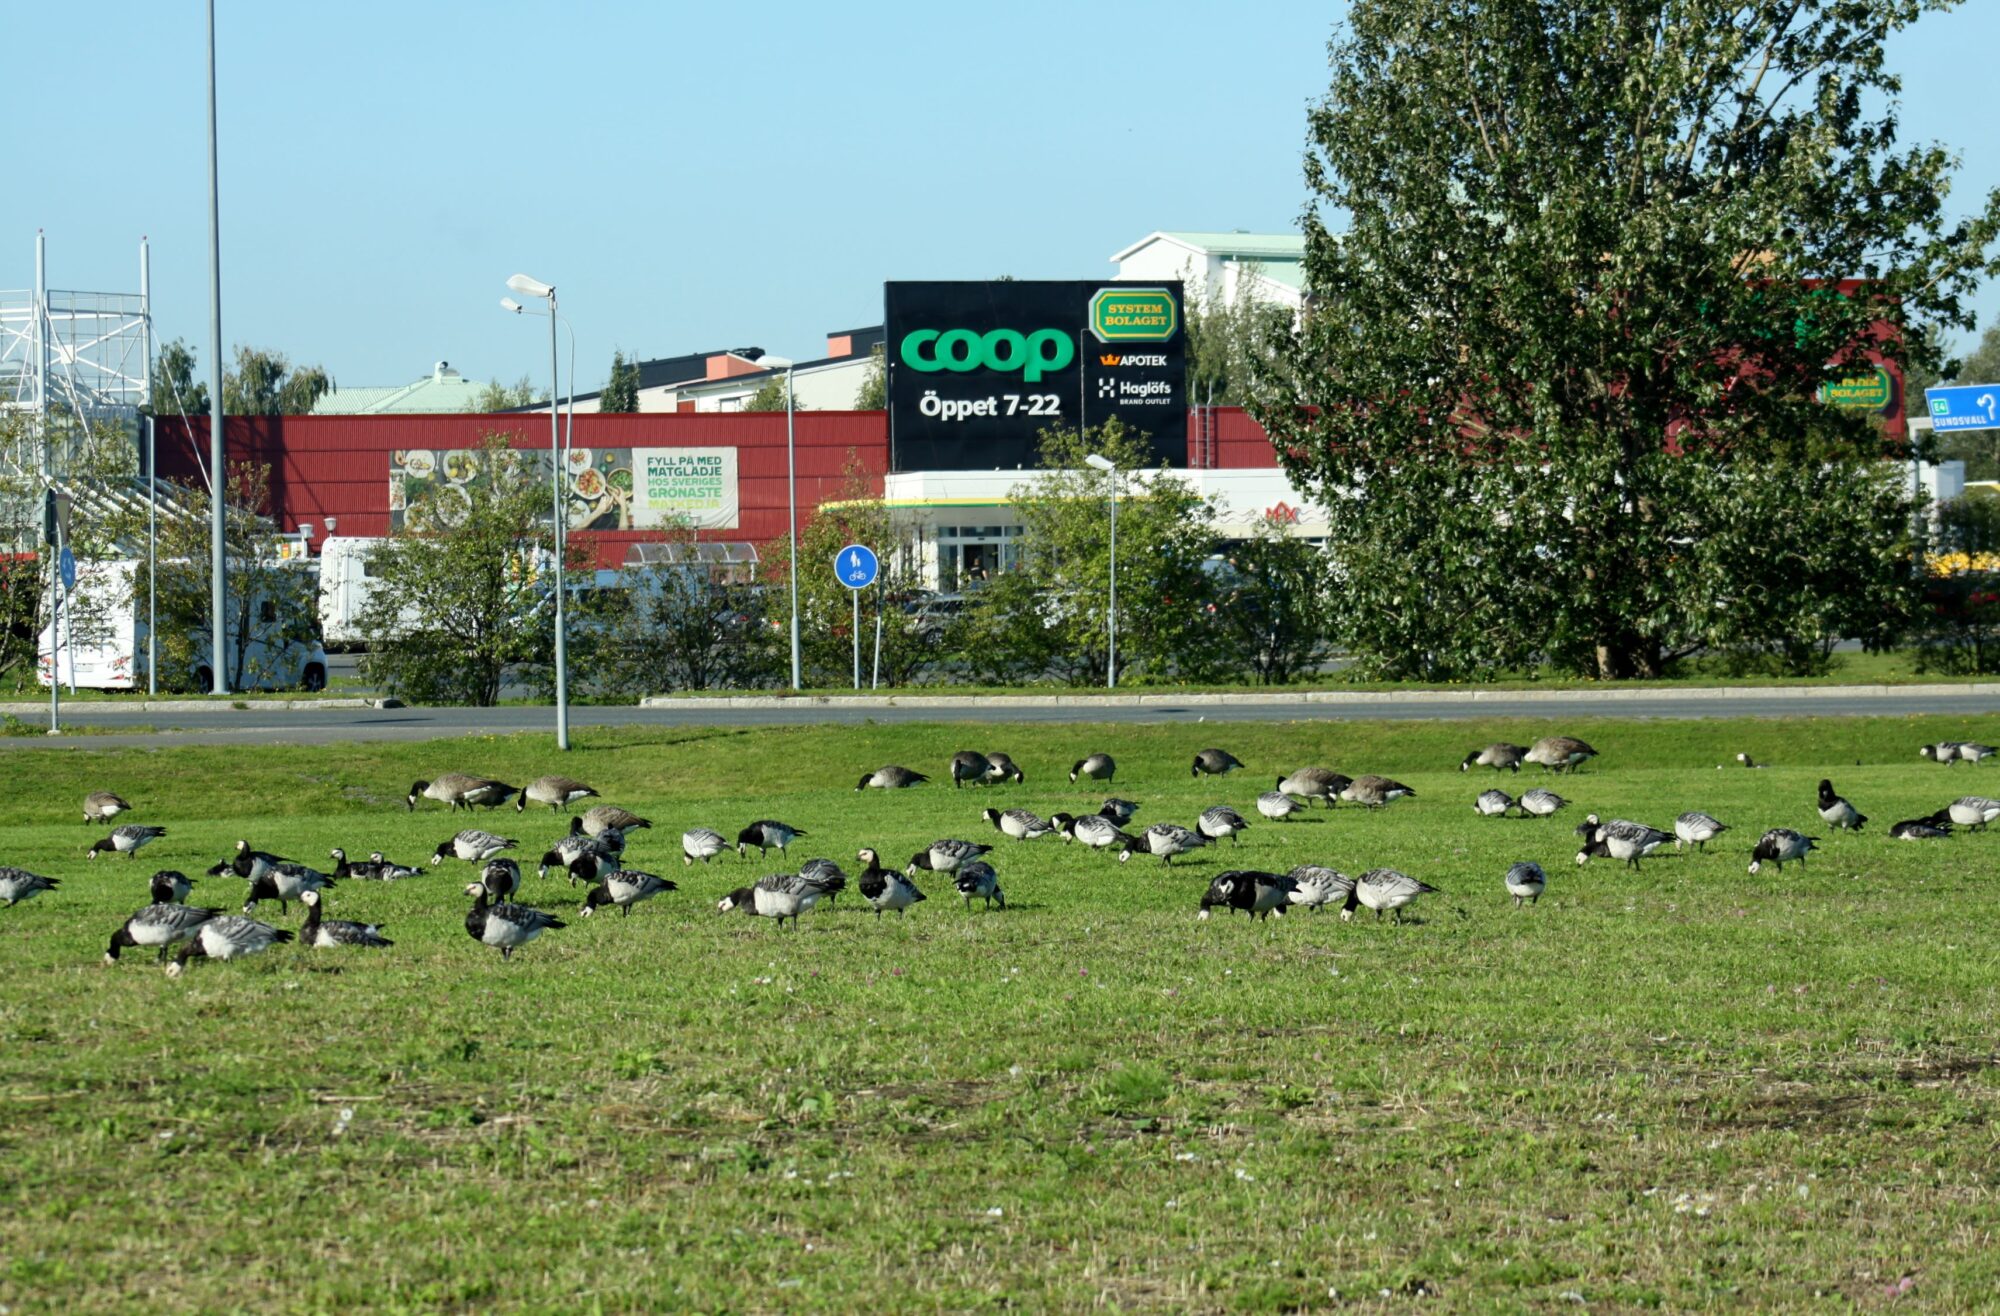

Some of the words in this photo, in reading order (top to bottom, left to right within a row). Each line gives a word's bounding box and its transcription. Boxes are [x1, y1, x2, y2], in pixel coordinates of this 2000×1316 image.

[1108, 304, 1163, 313] SYSTEM
[1105, 316, 1167, 325] BOLAGET
[901, 328, 1074, 382] coop
[1120, 355, 1167, 366] APOTEK
[1120, 381, 1171, 397] Haglöfs
[920, 390, 998, 421] Öppet
[1003, 395, 1060, 416] 7-22
[1933, 401, 1947, 412] E4
[1934, 415, 1987, 427] SUNDSVALL
[647, 457, 676, 466] FYLL
[678, 455, 694, 466] PÅ
[697, 456, 722, 466] MED
[648, 466, 722, 476] MATGLÄDJE
[648, 478, 669, 486] HOS
[671, 477, 722, 486] SVERIGES
[648, 487, 722, 498] GRÖNASTE
